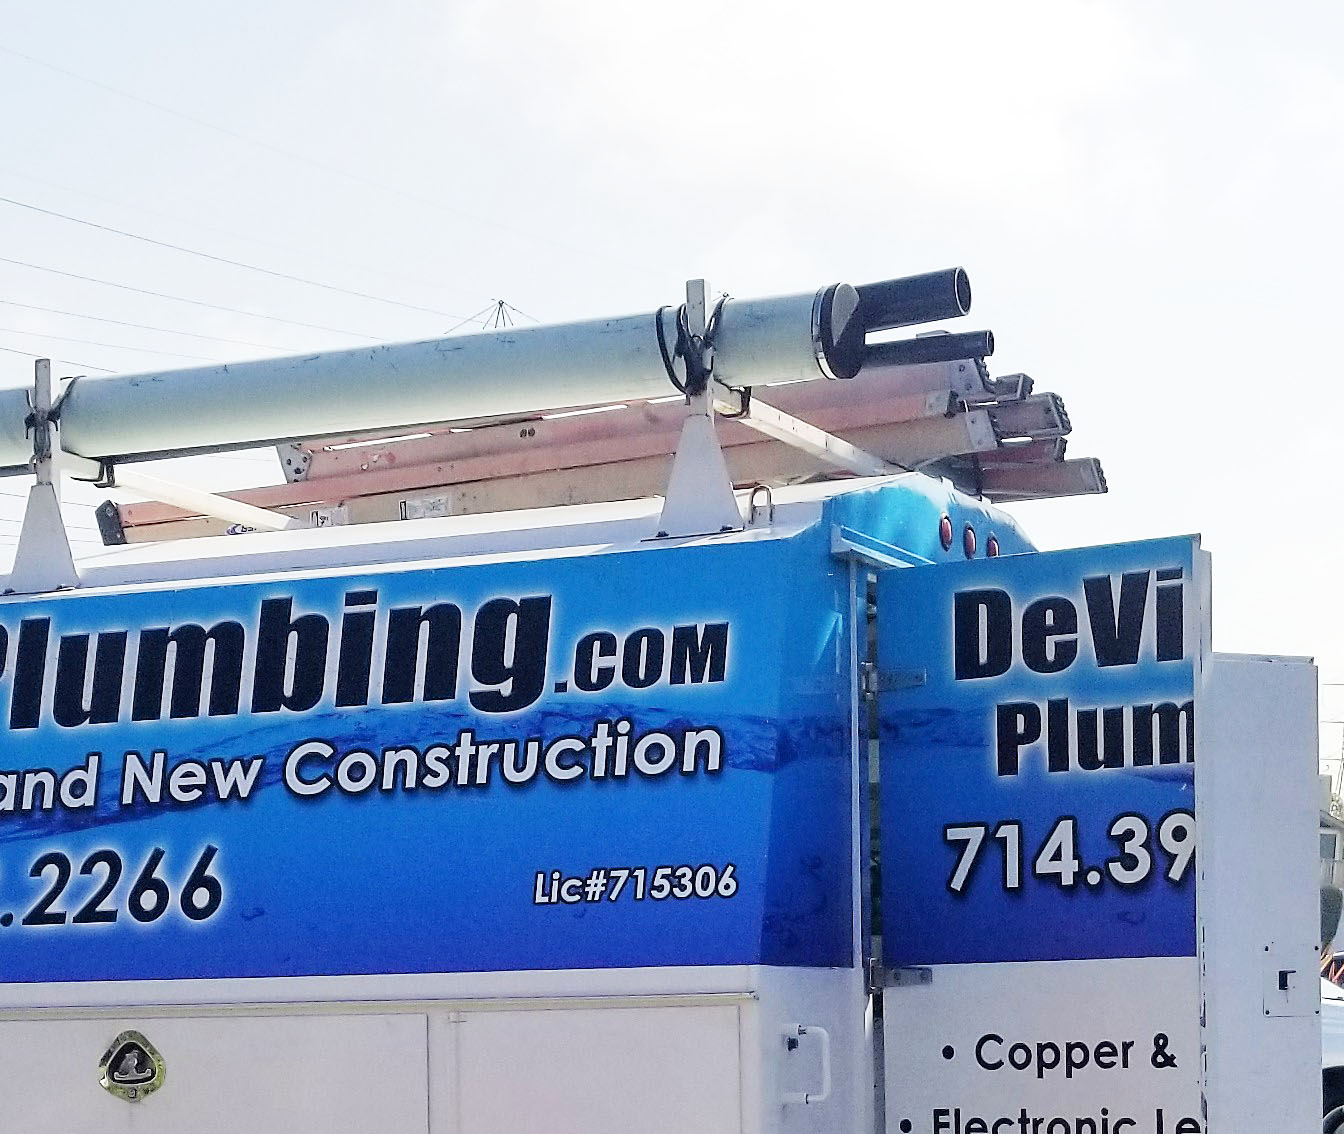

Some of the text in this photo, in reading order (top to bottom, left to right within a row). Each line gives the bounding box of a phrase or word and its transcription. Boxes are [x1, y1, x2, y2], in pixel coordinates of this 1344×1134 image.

[953, 567, 1184, 681] DeVi
[121, 751, 263, 806] New
[283, 721, 723, 797] Construction
[996, 698, 1195, 777] Plum
[534, 866, 737, 904] Lic#715306
[945, 812, 1195, 892] 714.39
[975, 1033, 1177, 1079] Copper &
